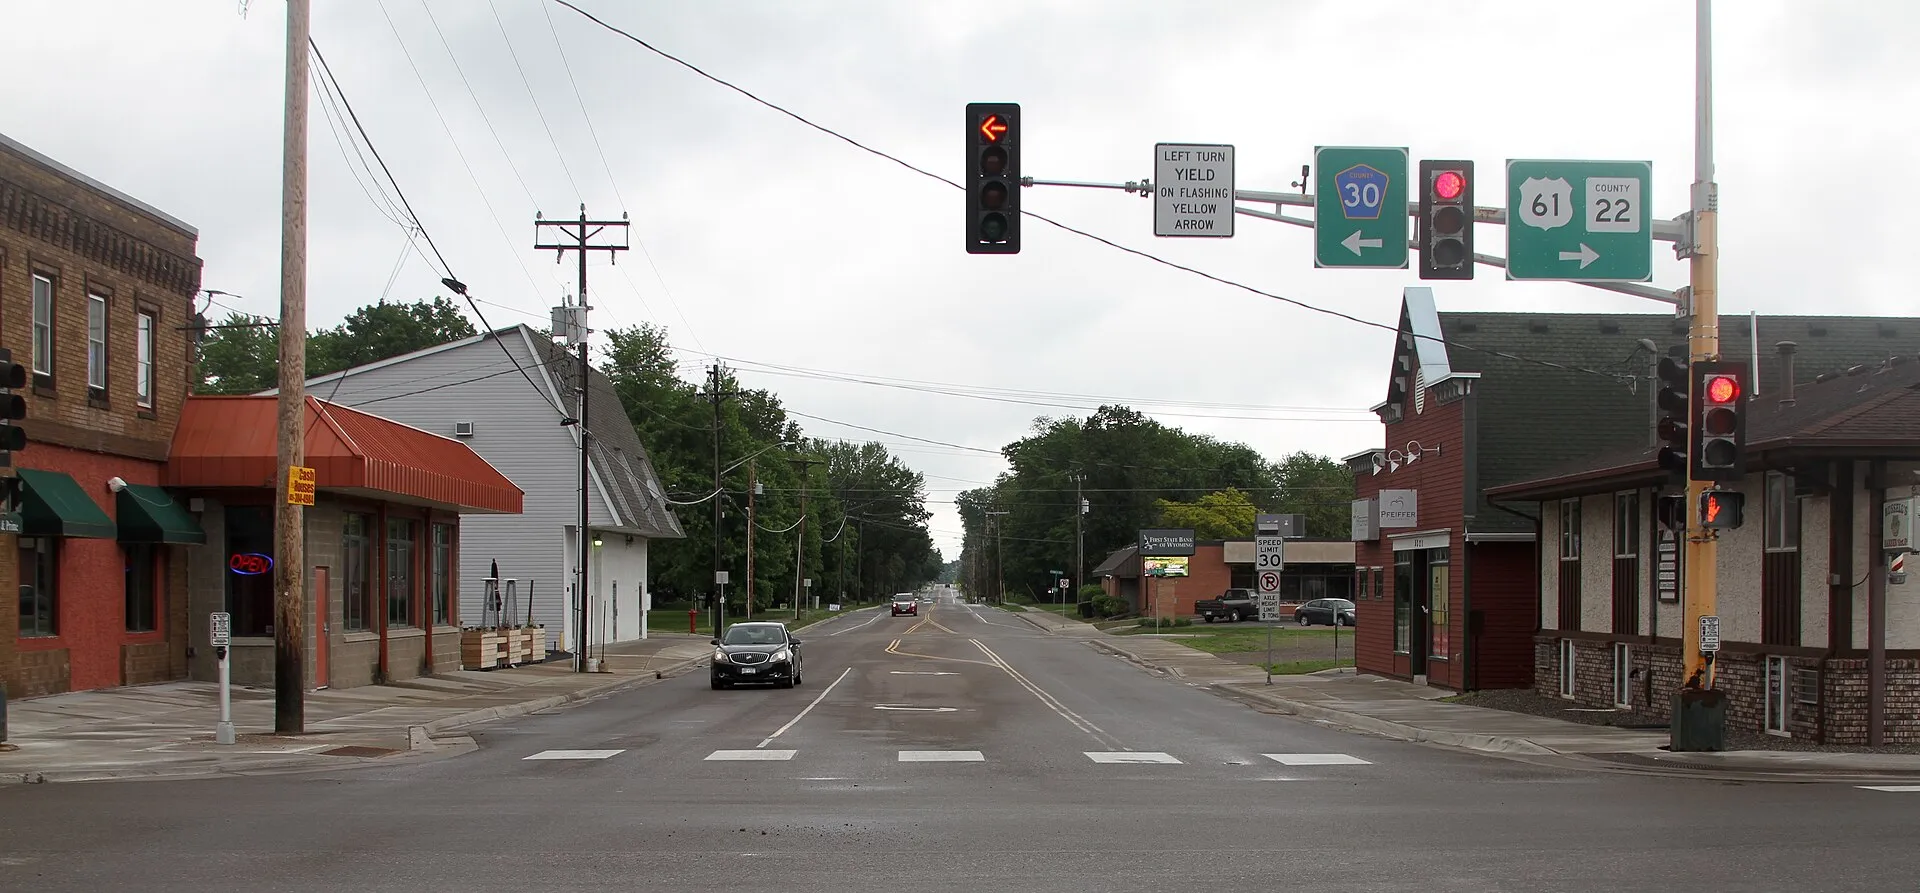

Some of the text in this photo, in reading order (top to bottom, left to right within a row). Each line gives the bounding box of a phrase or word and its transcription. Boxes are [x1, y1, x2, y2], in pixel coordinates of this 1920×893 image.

[1164, 151, 1225, 162] LEFT TURN
[1175, 168, 1215, 181] YIELD
[1160, 187, 1228, 198] ON FLASHING
[1595, 184, 1631, 192] COUNTY
[1344, 183, 1380, 208] 30
[1172, 203, 1216, 214] YELLOW
[1531, 193, 1559, 217] 61
[1595, 199, 1630, 222] 22
[1174, 220, 1214, 230] ARROW
[299, 468, 315, 481] Cash
[230, 554, 267, 573] OPEN
[1259, 554, 1281, 567] 30
